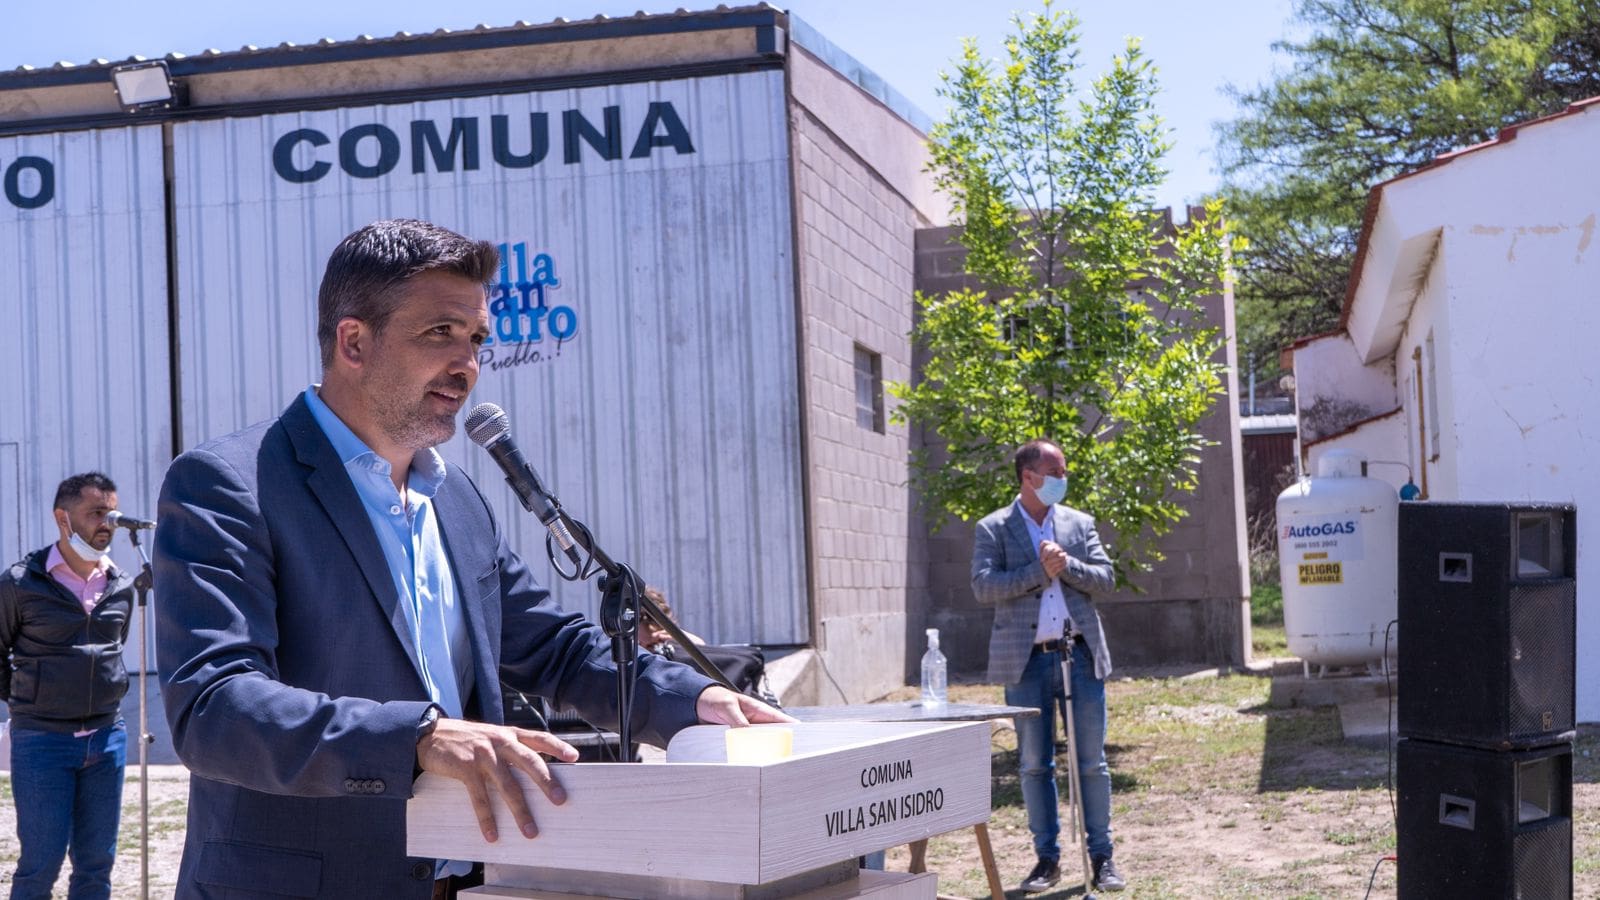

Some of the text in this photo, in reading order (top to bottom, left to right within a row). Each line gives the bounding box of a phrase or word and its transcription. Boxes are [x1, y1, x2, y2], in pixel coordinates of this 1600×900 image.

[272, 101, 697, 183] COMUNA
[0, 155, 55, 209] O
[498, 241, 558, 288] lla
[485, 296, 577, 343] dro
[490, 280, 548, 316] an
[1288, 521, 1355, 538] AutoGAS
[1299, 563, 1340, 575] PELIGRO
[860, 759, 913, 788] COMUNA
[825, 787, 944, 837] VILLA SAN ISIDRO
